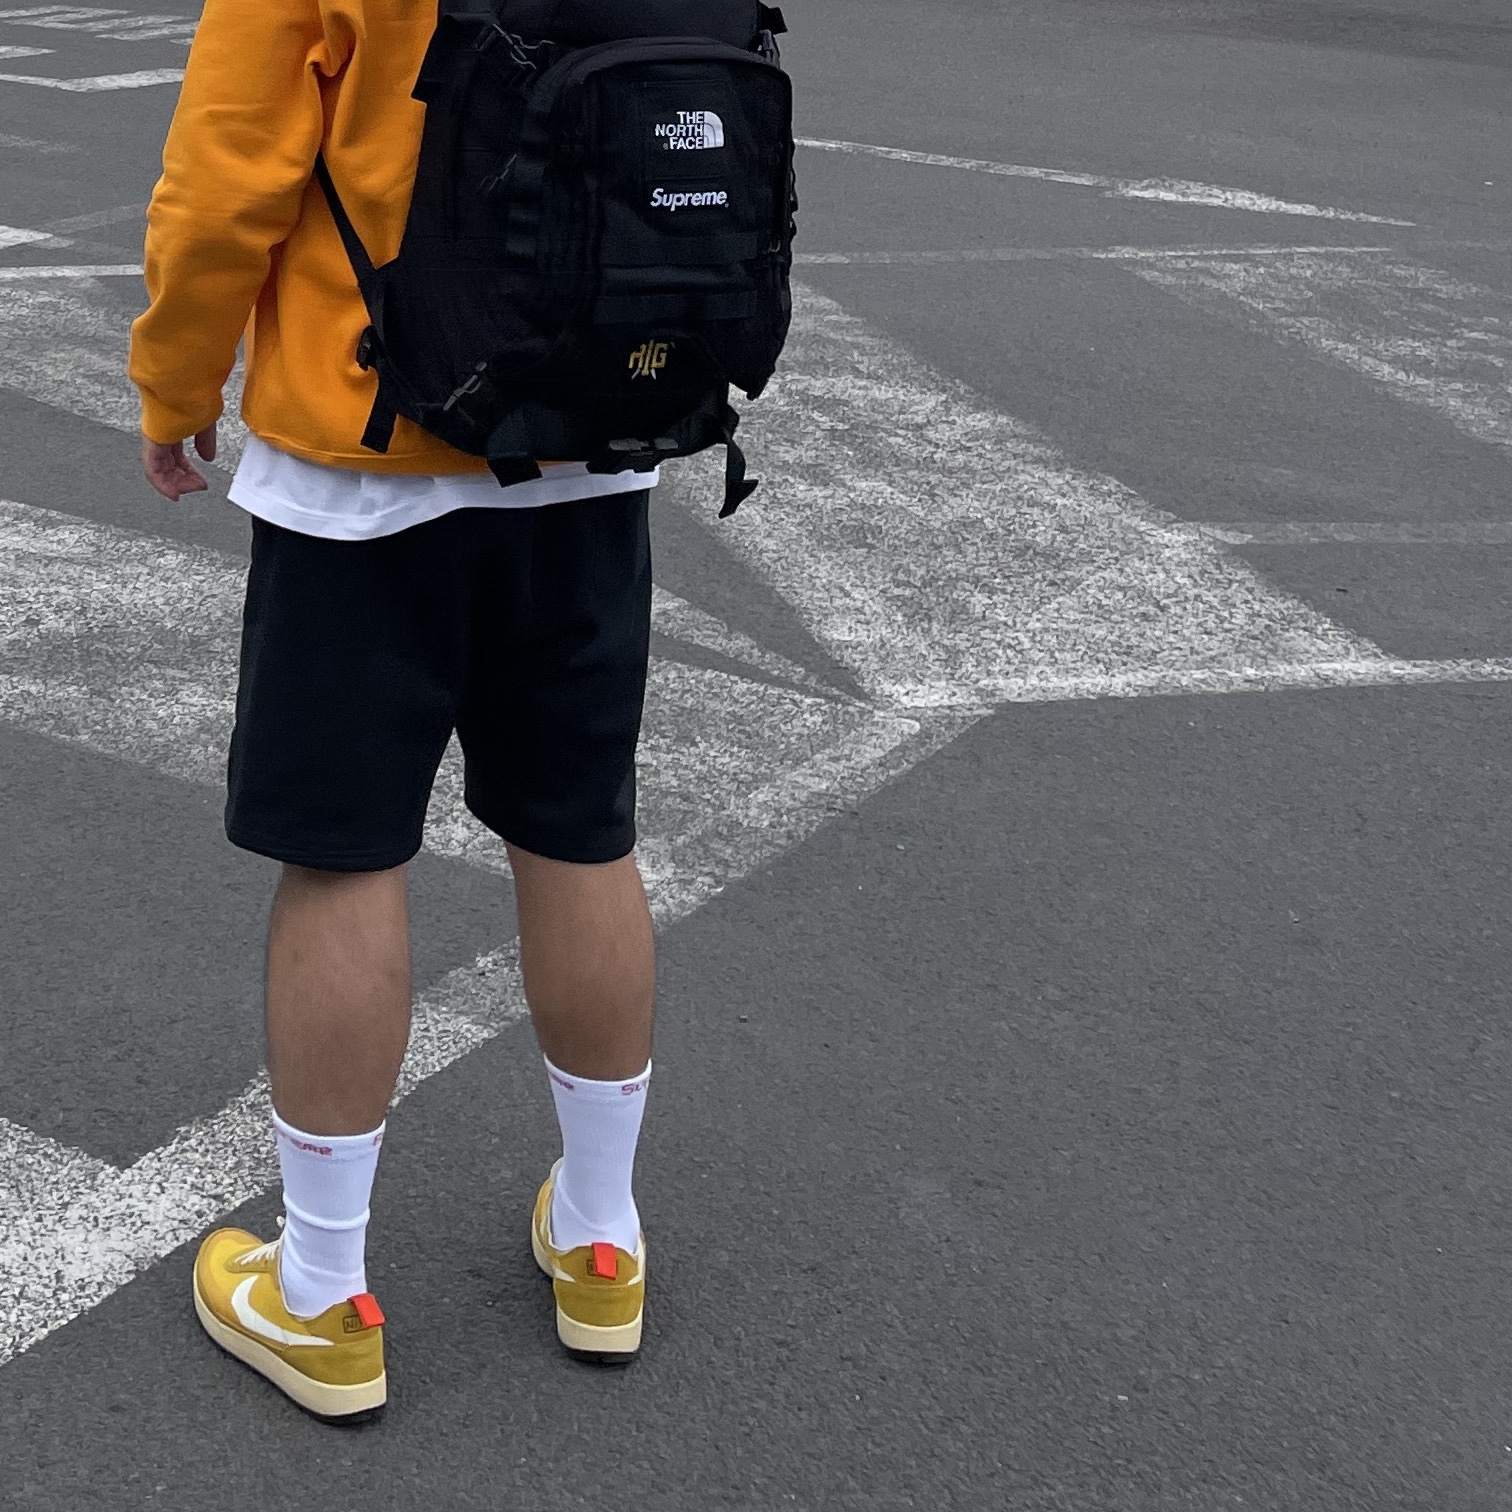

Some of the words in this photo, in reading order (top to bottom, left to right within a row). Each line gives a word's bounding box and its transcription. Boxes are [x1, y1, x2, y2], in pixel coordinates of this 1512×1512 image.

[677, 111, 704, 124] THE
[655, 124, 704, 137] NORTH
[669, 137, 704, 150] FACE
[650, 188, 728, 212] Supreme
